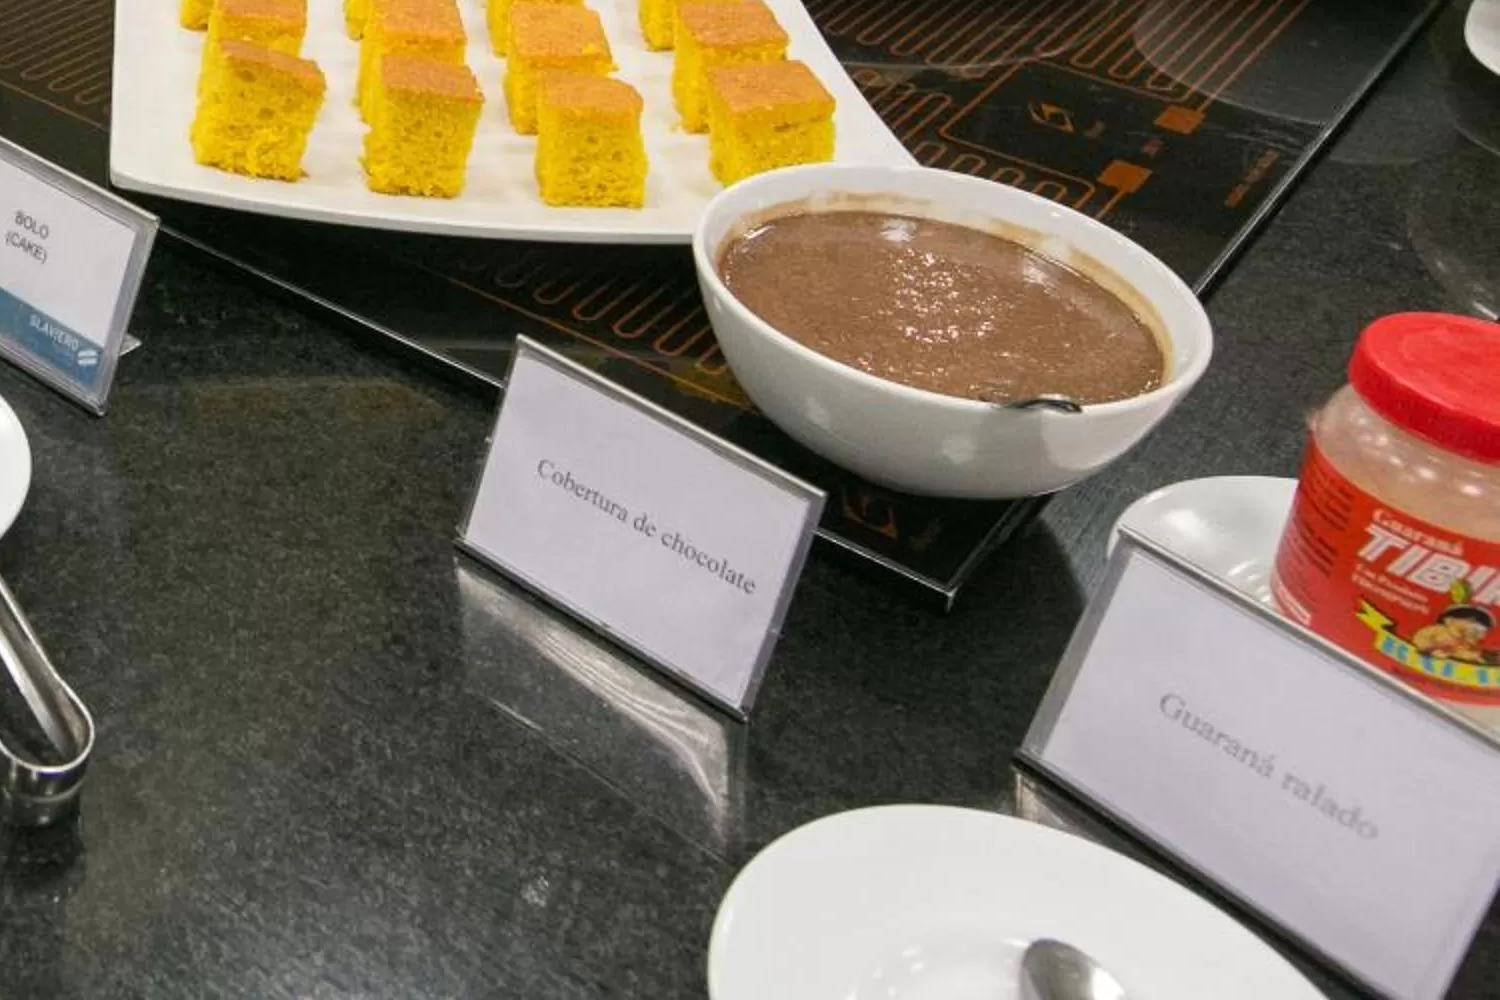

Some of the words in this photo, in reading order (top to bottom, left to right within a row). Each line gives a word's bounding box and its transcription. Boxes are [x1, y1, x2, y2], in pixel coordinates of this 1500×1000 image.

[5, 231, 47, 264] (CAKE)
[15, 211, 49, 240] BOLO
[537, 459, 629, 523] Cobertura
[633, 512, 657, 538] de
[660, 532, 756, 595] chocolate
[1159, 693, 1276, 779] Guaraná
[1281, 772, 1378, 840] ralado
